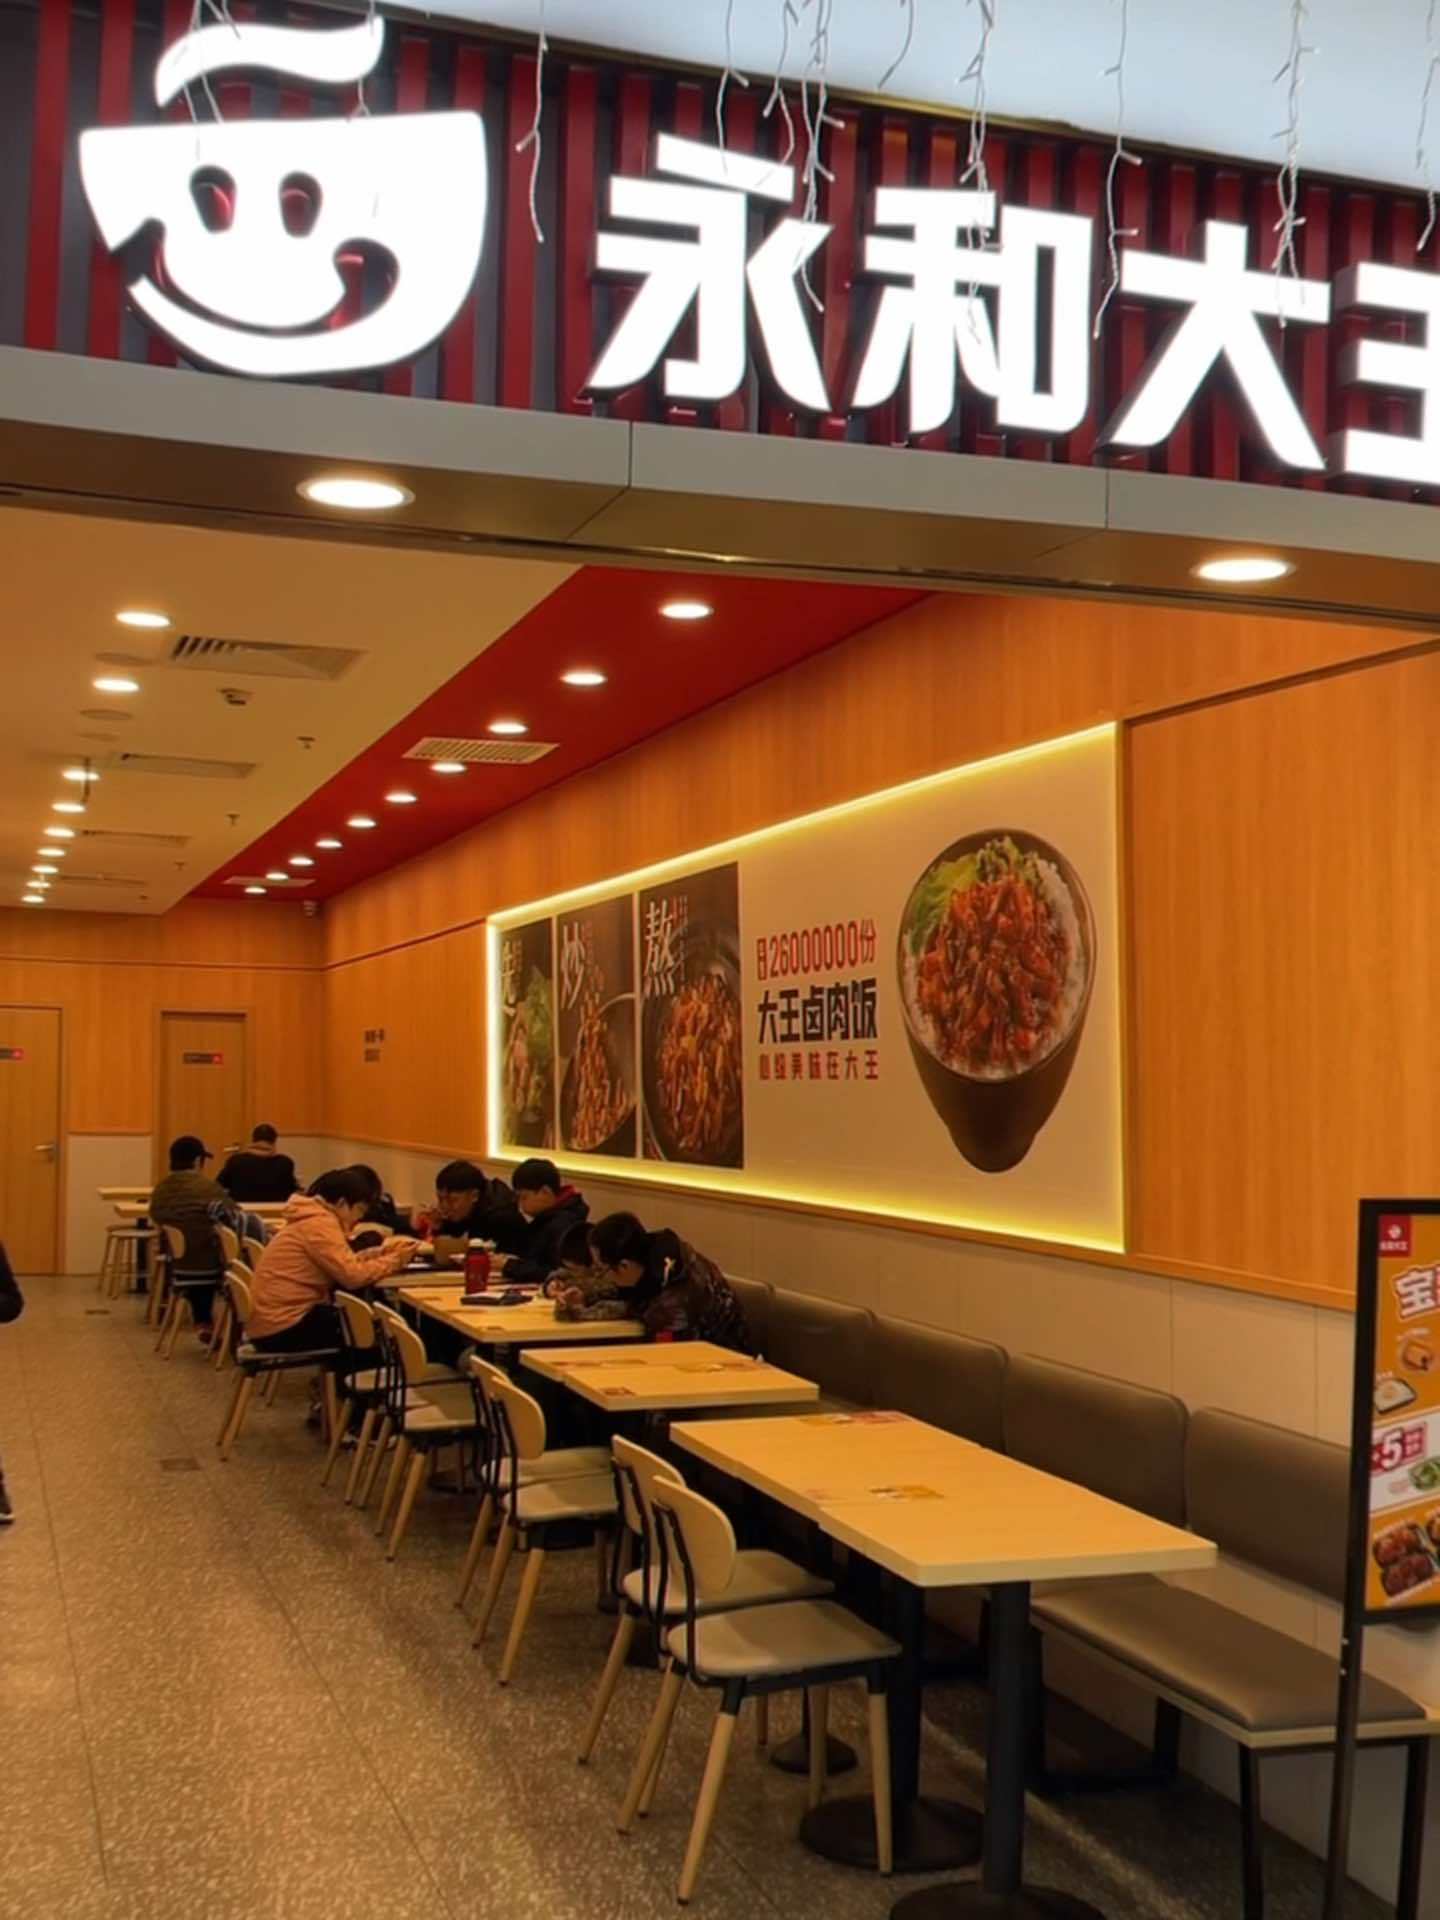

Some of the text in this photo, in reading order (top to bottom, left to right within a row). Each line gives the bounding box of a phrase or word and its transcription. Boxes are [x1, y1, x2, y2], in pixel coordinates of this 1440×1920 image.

[758, 978, 878, 1044] 大王卤肉饭
